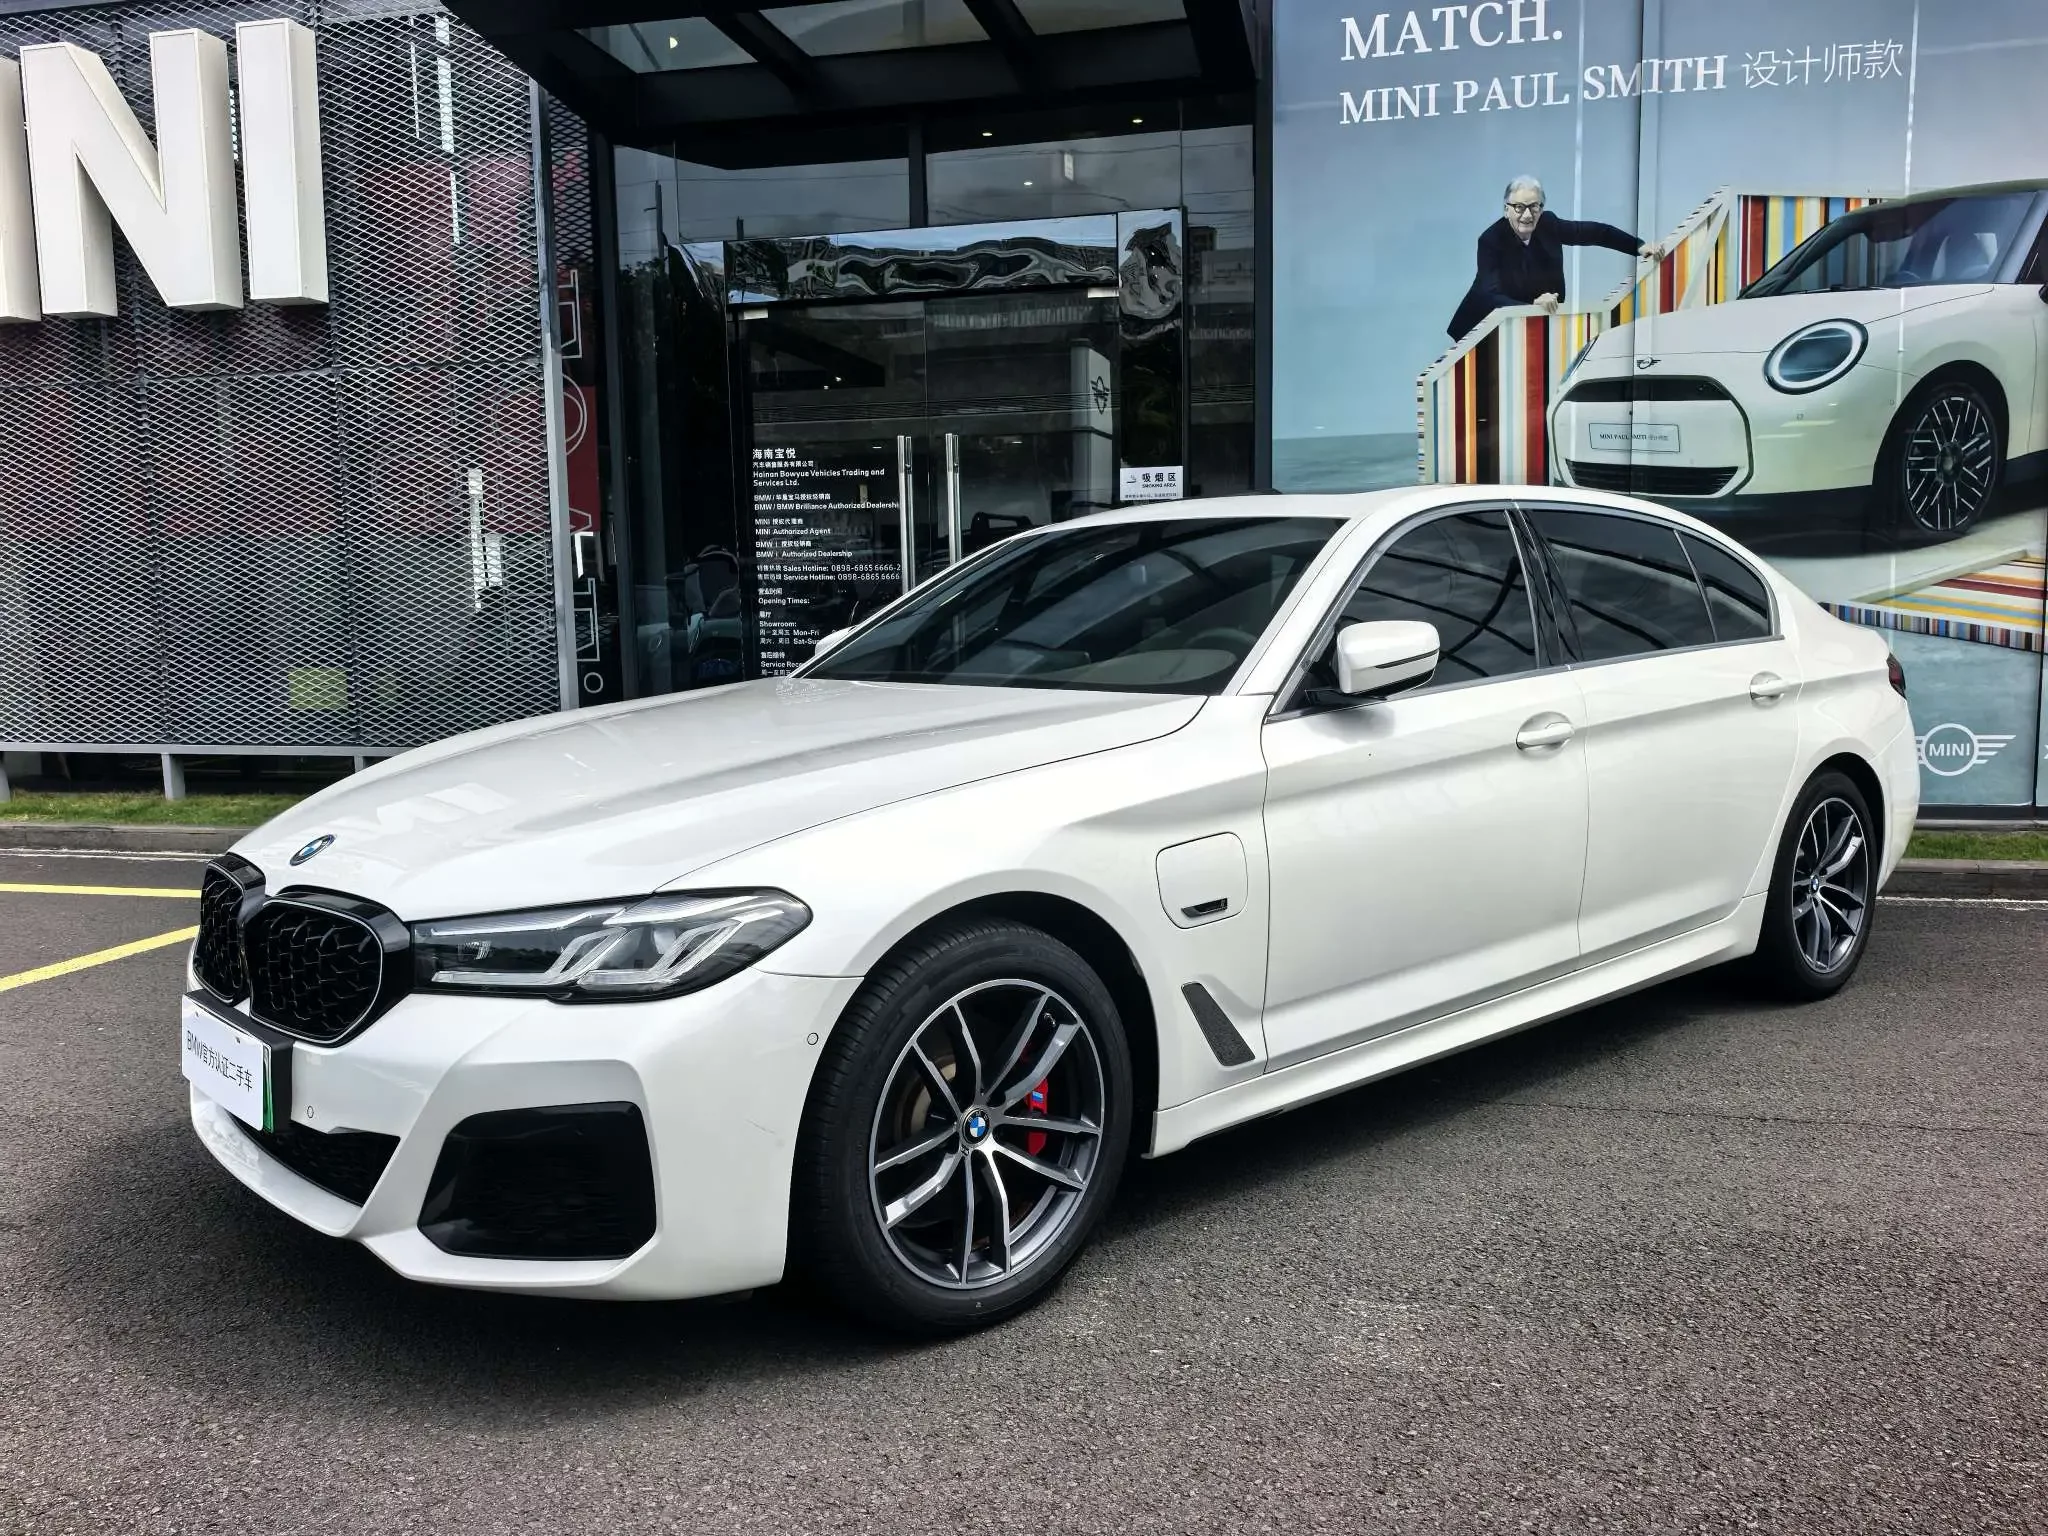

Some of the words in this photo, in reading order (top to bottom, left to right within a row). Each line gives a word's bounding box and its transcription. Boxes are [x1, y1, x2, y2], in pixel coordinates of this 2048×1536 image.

[1340, 0, 1563, 61] MATCH.
[1340, 83, 1441, 125] MINI
[1453, 72, 1570, 114] PAUL
[1583, 55, 1728, 101] SMITH
[1742, 38, 1904, 89] 设计师款
[753, 448, 796, 459] 海南宝悦
[780, 470, 809, 479] Bowyue
[810, 469, 841, 477] Vehicles
[842, 469, 869, 477] Trading
[871, 468, 885, 476] and
[1142, 472, 1177, 482] 吸烟区
[754, 503, 773, 511] BMW
[828, 501, 866, 509] Authorized
[809, 527, 831, 536] Agent
[782, 550, 817, 558] Authorized
[817, 550, 853, 559] Dealership
[802, 564, 829, 572] Hotline:
[831, 564, 873, 572] 0898-6865
[809, 573, 836, 581] Hotline:
[759, 620, 797, 628] Showroom:
[1929, 742, 1971, 757] MINI
